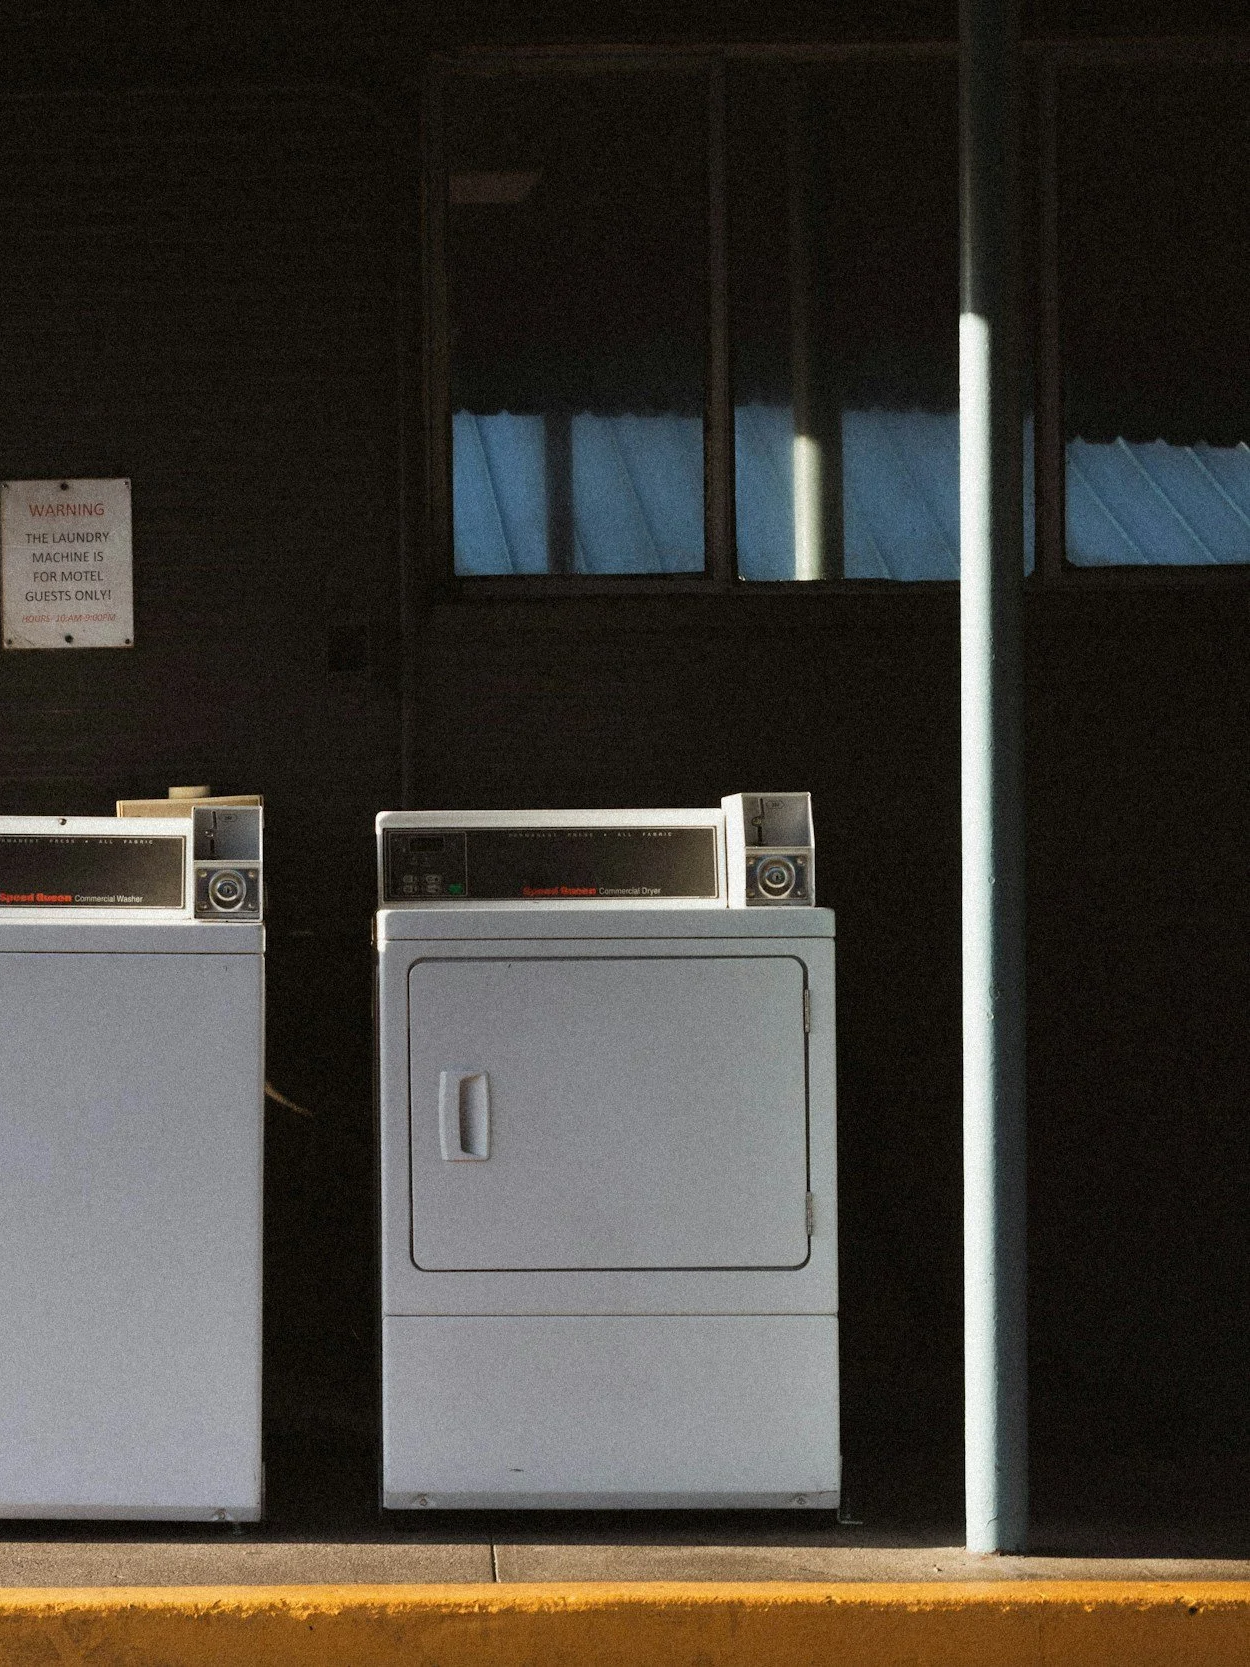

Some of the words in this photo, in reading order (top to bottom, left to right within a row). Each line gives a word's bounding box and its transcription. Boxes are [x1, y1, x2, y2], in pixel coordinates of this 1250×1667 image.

[29, 503, 105, 517] WARNING
[25, 533, 48, 544] THE
[52, 532, 110, 543] LAUNDRY
[32, 552, 90, 563] MACHINE
[94, 551, 104, 562] IS
[33, 571, 57, 582] FOR
[61, 571, 104, 582] MOTEL
[25, 591, 71, 602] GUESTS
[75, 590, 111, 601] ONLY!
[0, 892, 34, 903] Speed
[35, 892, 72, 902] Queen
[74, 895, 115, 903] Commercial
[116, 895, 143, 903] Washer
[599, 887, 640, 895] Commercial
[641, 887, 661, 896] Dryer
